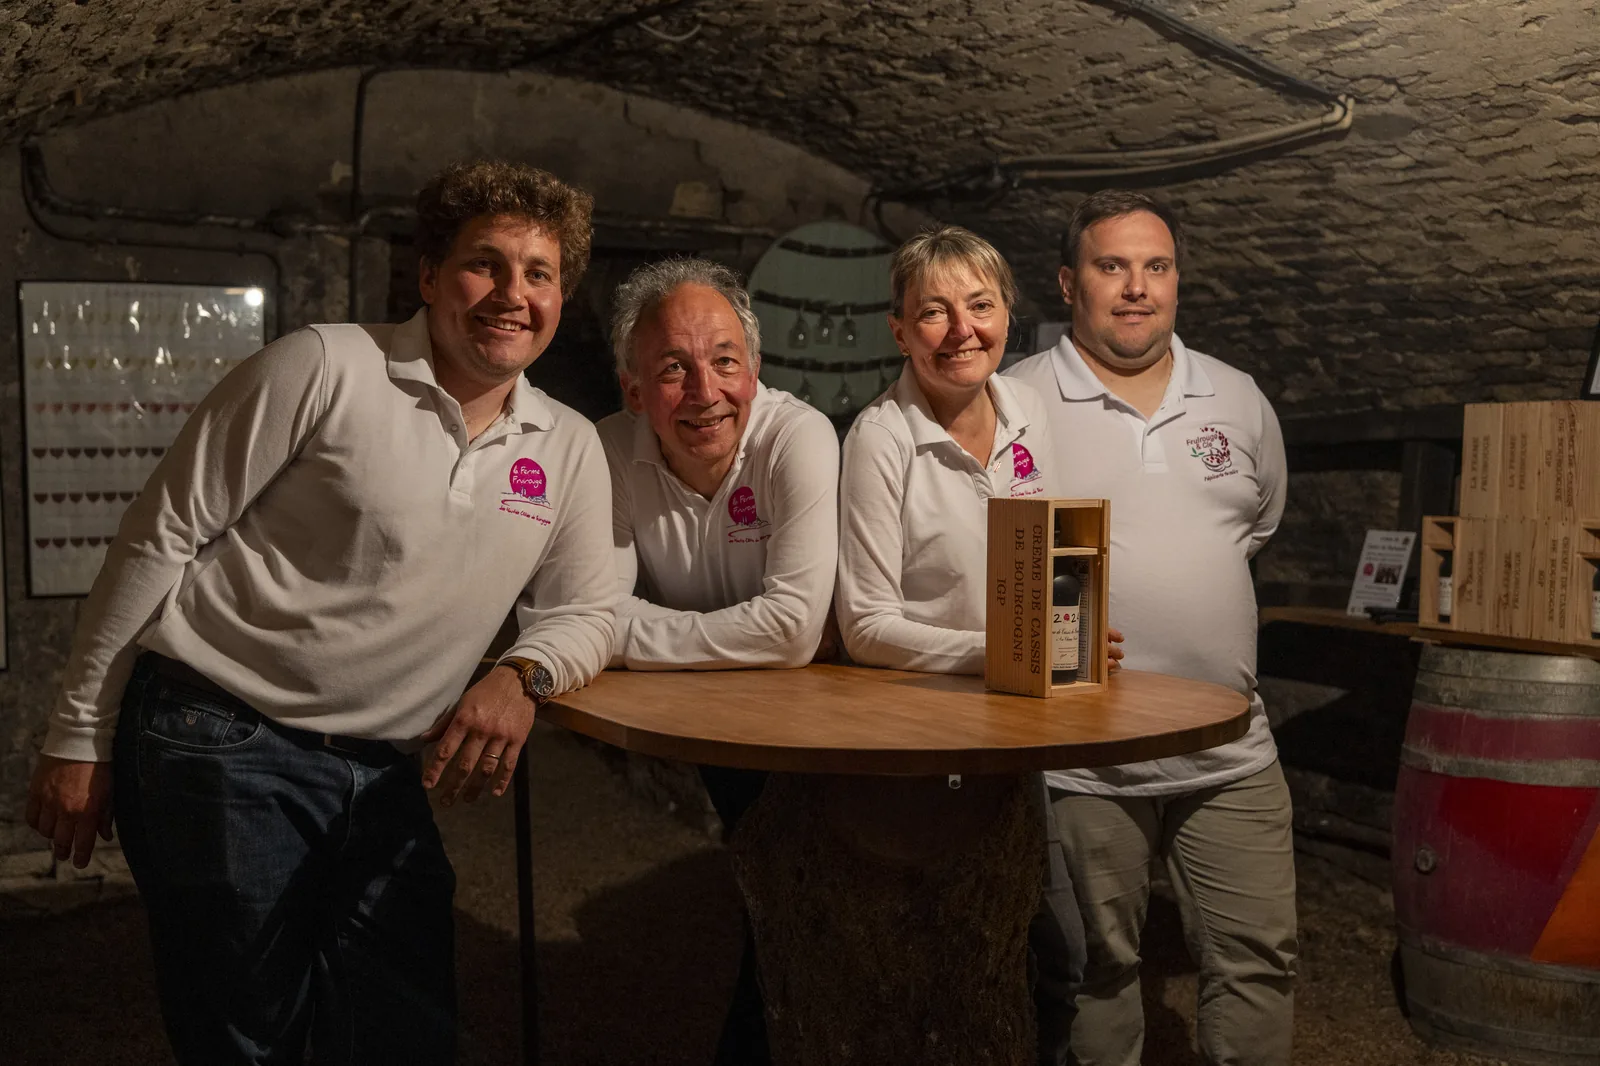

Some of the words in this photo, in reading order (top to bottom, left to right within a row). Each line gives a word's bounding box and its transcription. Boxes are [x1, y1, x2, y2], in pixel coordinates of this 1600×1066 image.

[1557, 418, 1565, 432] DE
[1186, 434, 1218, 446] Fruirouge
[1202, 441, 1213, 449] Cie
[1509, 434, 1517, 470] FERME
[520, 466, 540, 475] Ferme
[1555, 437, 1564, 501] BOURGOGNE
[512, 475, 543, 488] Fruirouge
[1470, 476, 1477, 489] LA
[1508, 474, 1515, 488] LA
[1015, 527, 1025, 551] DE
[1031, 523, 1043, 581] CREME
[997, 578, 1007, 606] IGP
[1548, 558, 1557, 622] BOURGOGNE
[1560, 576, 1568, 591] DE
[1031, 588, 1042, 611] DE
[1013, 560, 1025, 663] BOURGOGNE
[1559, 594, 1567, 630] CASSIS
[1030, 617, 1041, 674] CASSIS
[180, 706, 210, 717] GANT
